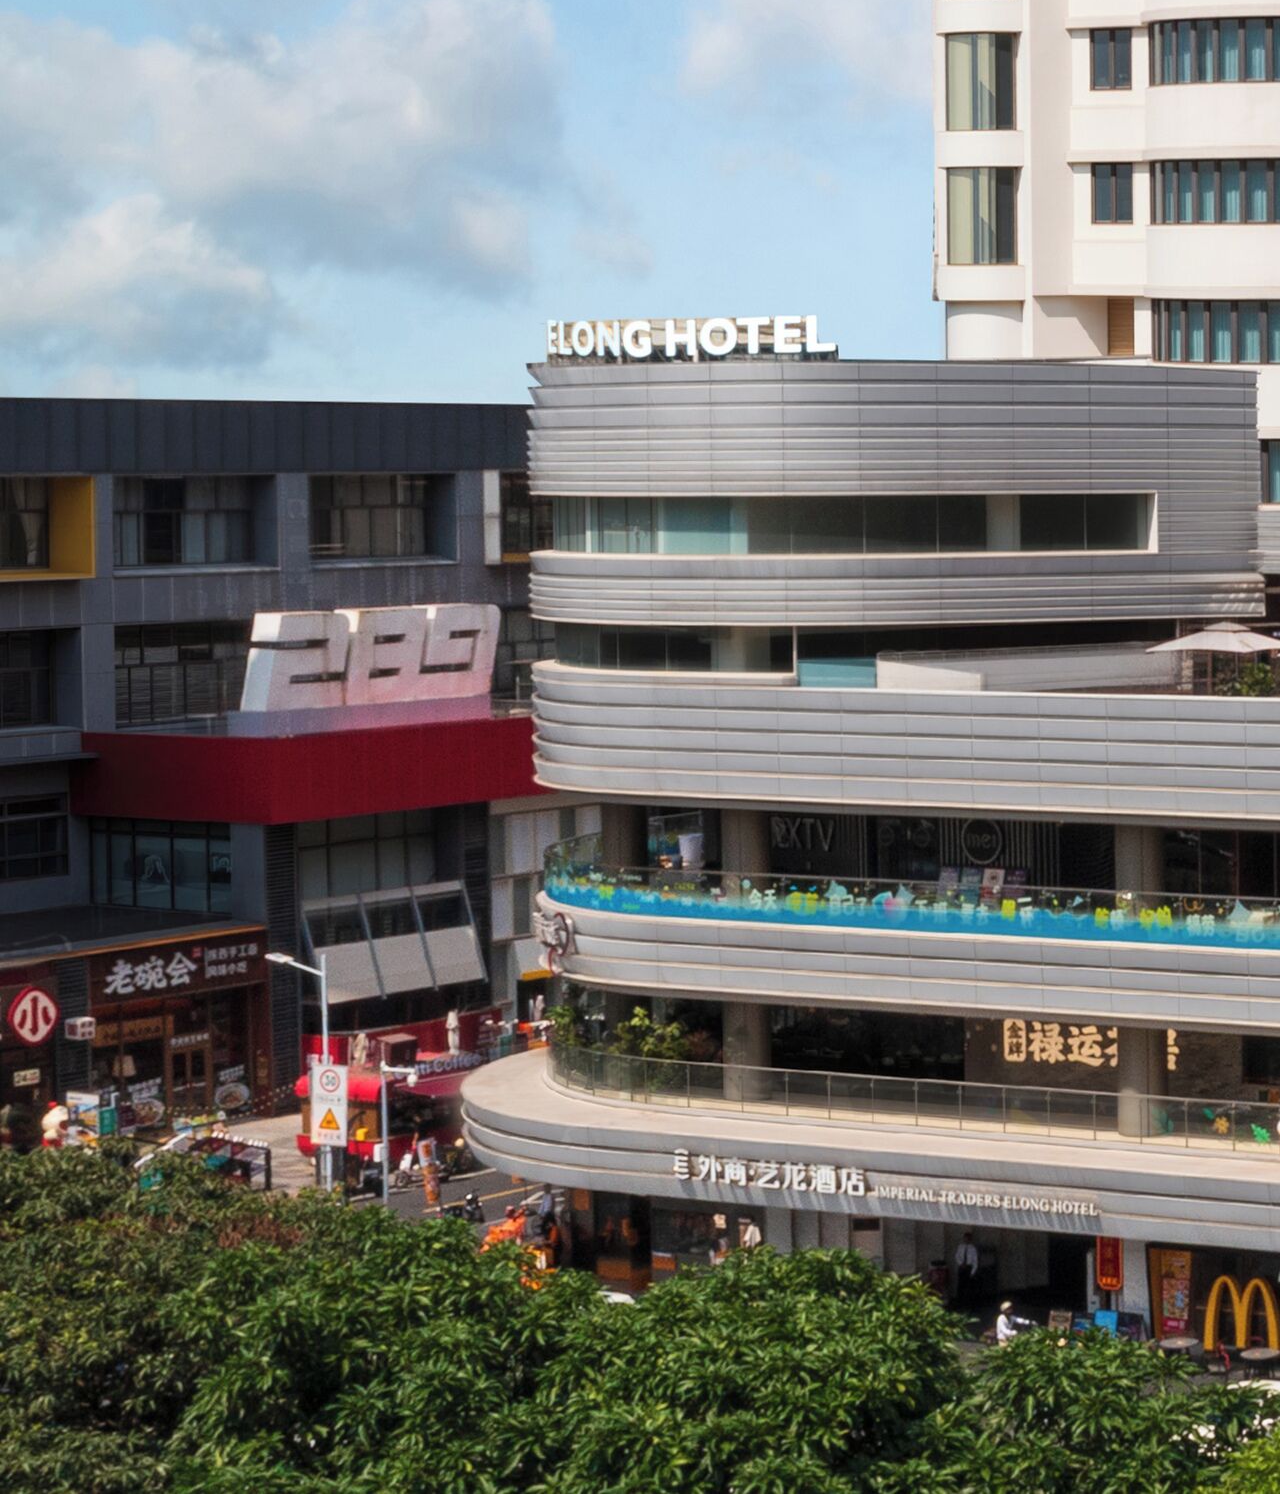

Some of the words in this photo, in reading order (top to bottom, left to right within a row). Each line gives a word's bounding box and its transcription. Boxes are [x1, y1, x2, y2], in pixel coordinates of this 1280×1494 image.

[546, 318, 653, 358] ELONG
[663, 314, 837, 357] HOTEL
[103, 952, 198, 995] 老碗会
[698, 1153, 867, 1196] 外商·艺龙酒店
[874, 1185, 937, 1204] IMPERIAL
[940, 1190, 1001, 1209] TRADERS
[1003, 1195, 1050, 1213] ELONG
[1051, 1198, 1099, 1217] HOTEL
